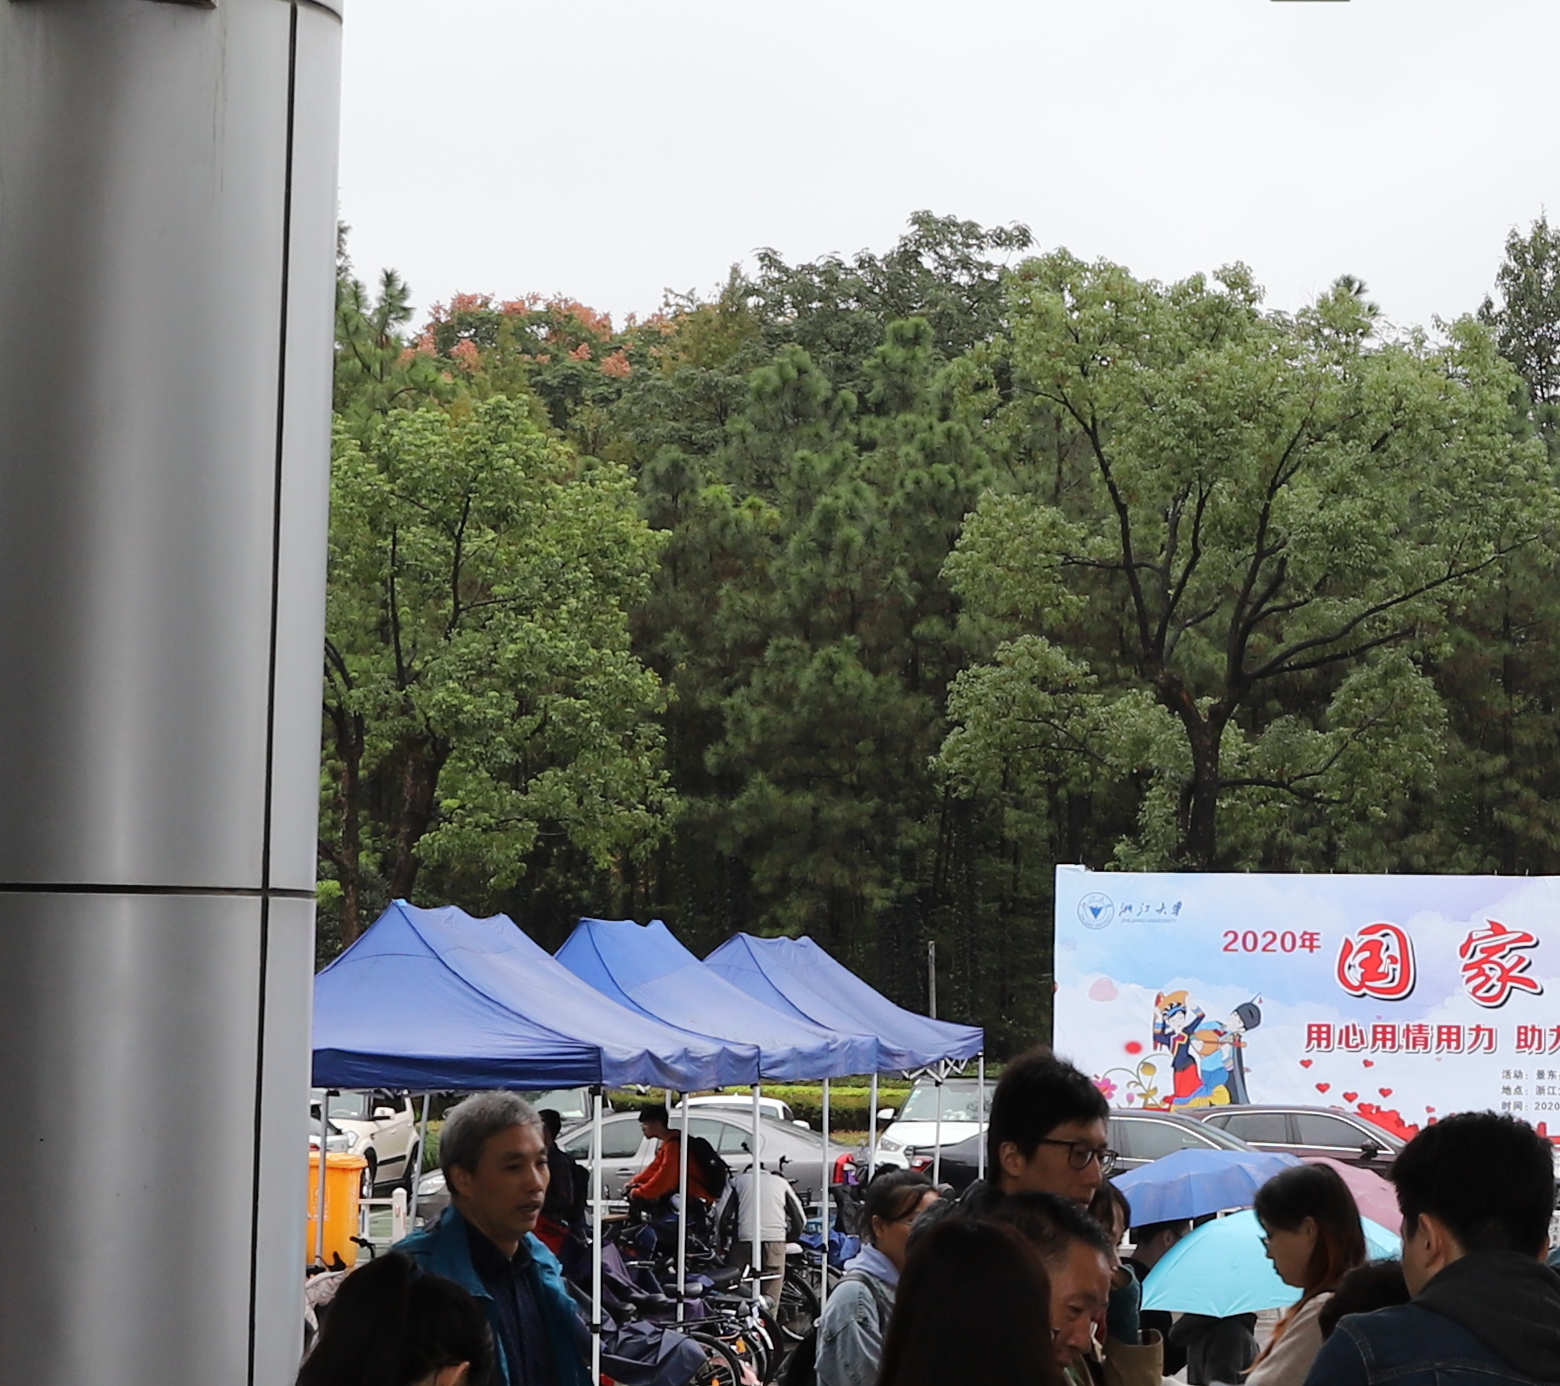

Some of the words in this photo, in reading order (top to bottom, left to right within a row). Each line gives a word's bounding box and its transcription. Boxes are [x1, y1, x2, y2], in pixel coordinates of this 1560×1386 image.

[1118, 900, 1183, 917] 浙江大学
[1222, 930, 1322, 954] 2020年
[1304, 1022, 1499, 1054] 用心用情用力
